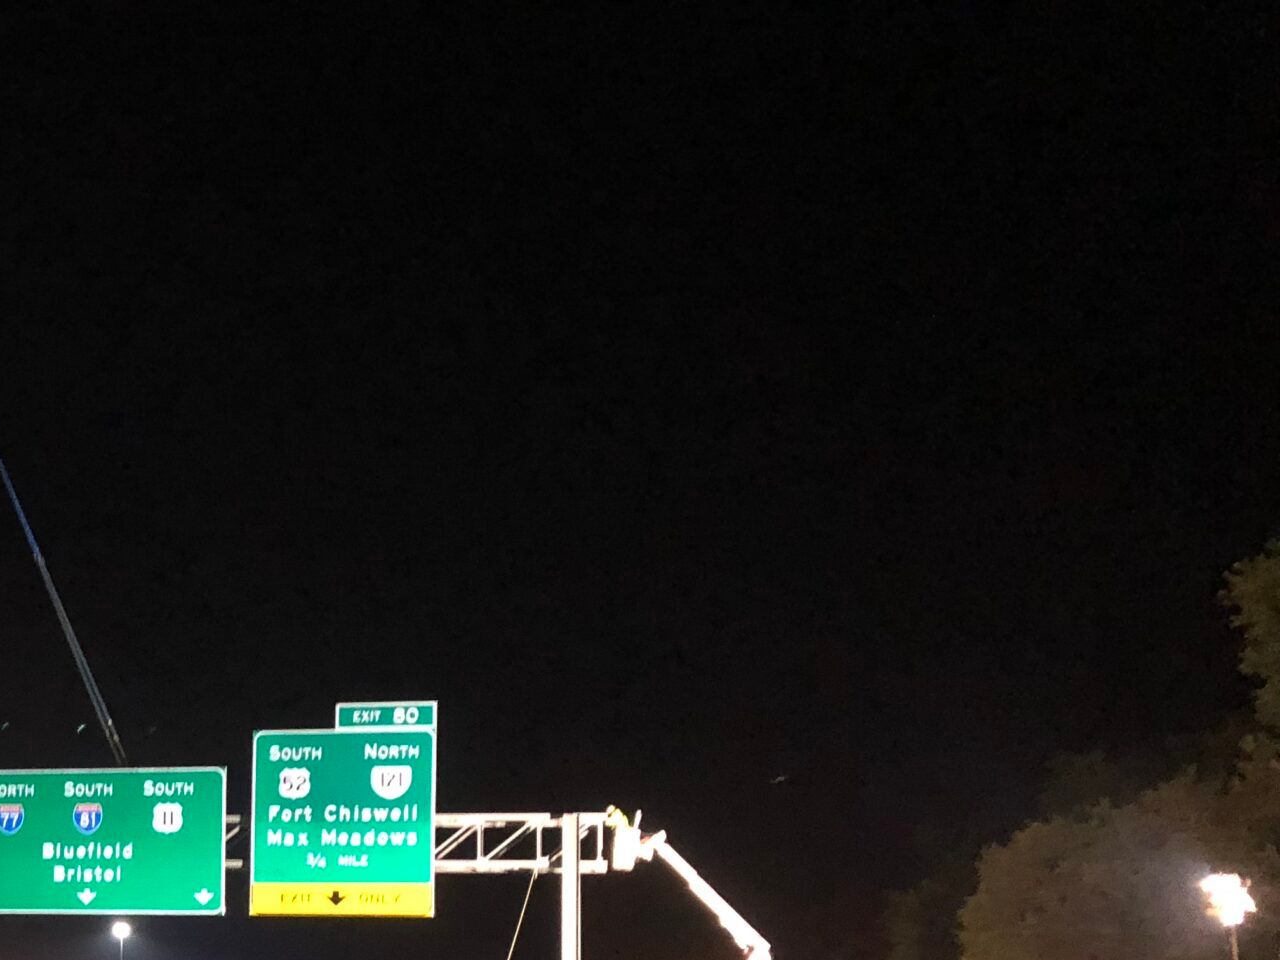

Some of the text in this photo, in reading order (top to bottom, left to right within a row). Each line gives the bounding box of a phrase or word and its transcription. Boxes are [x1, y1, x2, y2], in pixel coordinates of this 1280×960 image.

[352, 707, 419, 724] EXIT 80
[269, 743, 420, 762] SOUTH NORTH
[64, 780, 113, 797] SOUTH
[143, 779, 194, 797] SOUTH
[283, 775, 306, 791] 52
[0, 812, 20, 828] 77
[80, 812, 96, 829] 81
[163, 811, 174, 825] 11
[268, 803, 418, 823] Fort Chiswell
[267, 828, 418, 847] Max Meadows
[42, 841, 133, 860] Bluefield
[338, 854, 369, 867] MILE
[53, 864, 122, 883] Bristol
